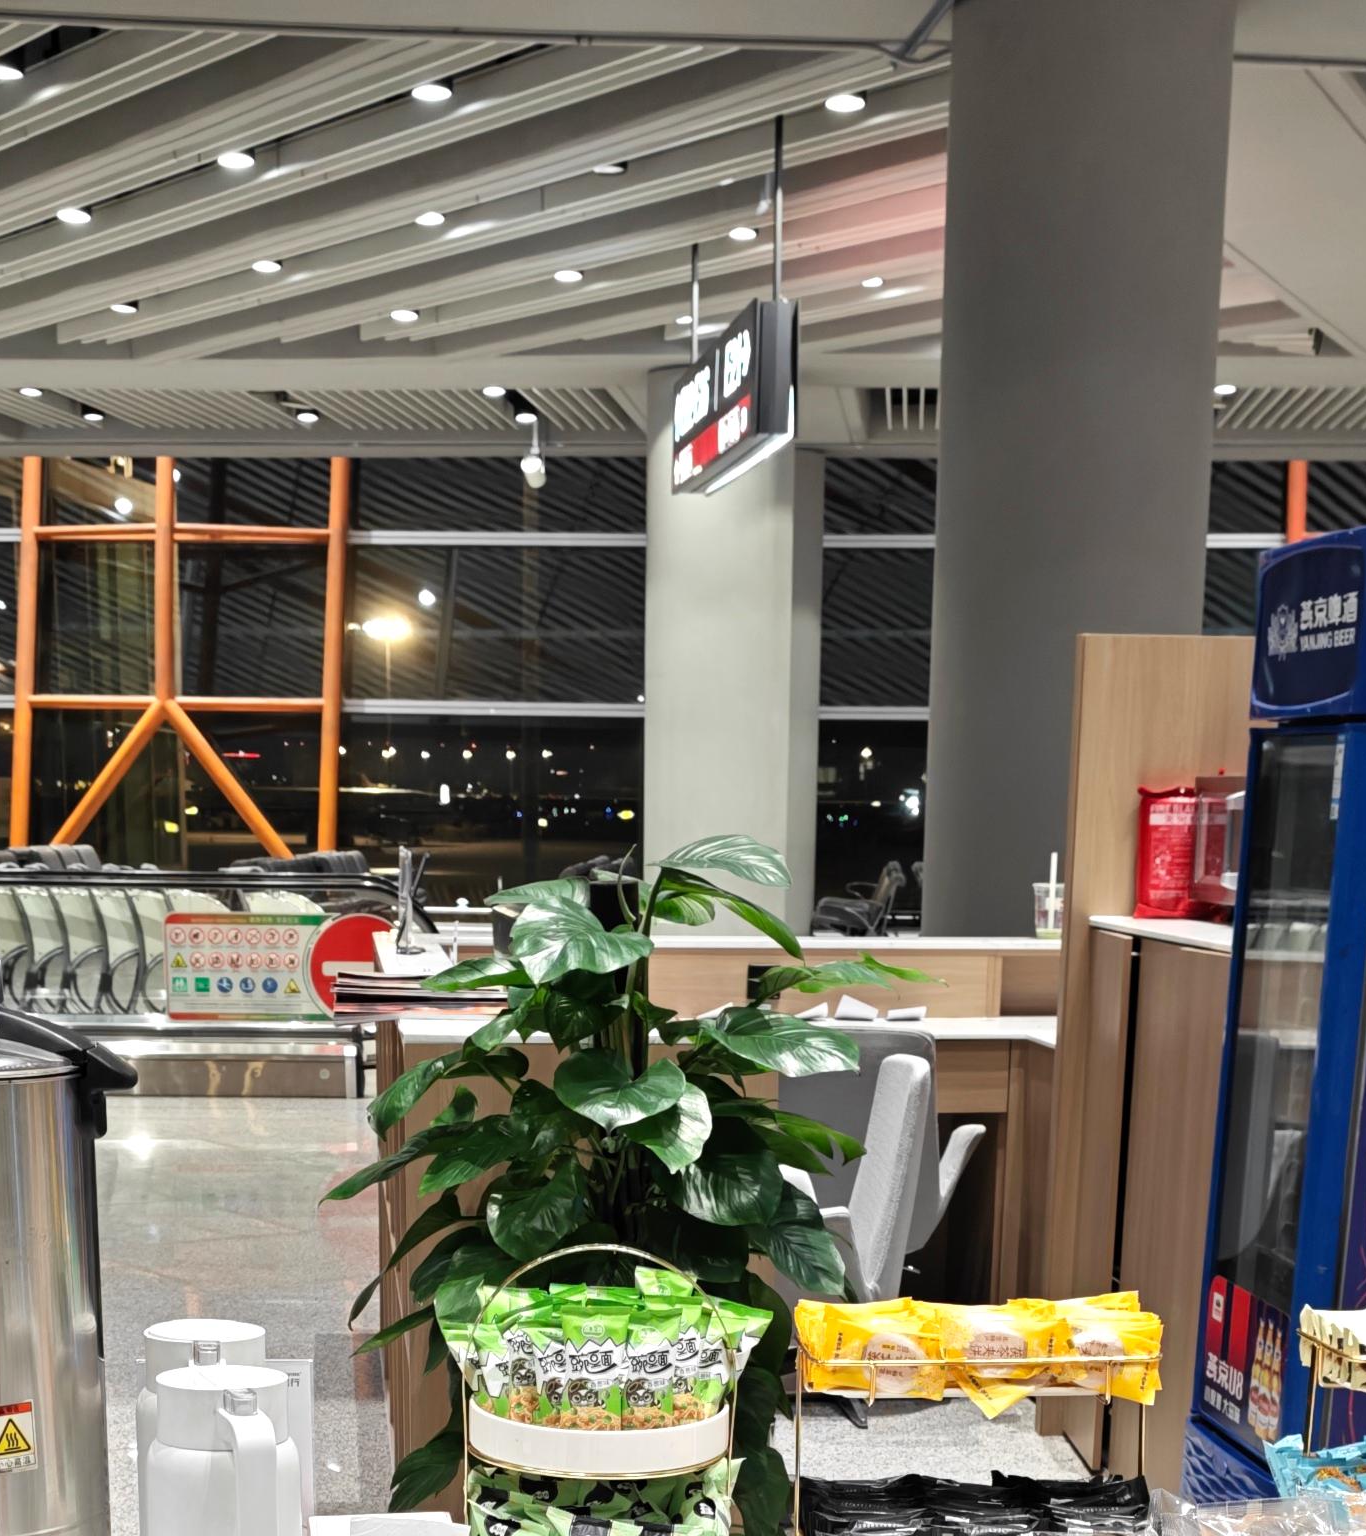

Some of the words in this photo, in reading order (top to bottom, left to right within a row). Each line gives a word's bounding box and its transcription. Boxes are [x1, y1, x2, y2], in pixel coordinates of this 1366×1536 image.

[1300, 591, 1359, 631] 燕京啤酒
[1334, 628, 1356, 648] BEER
